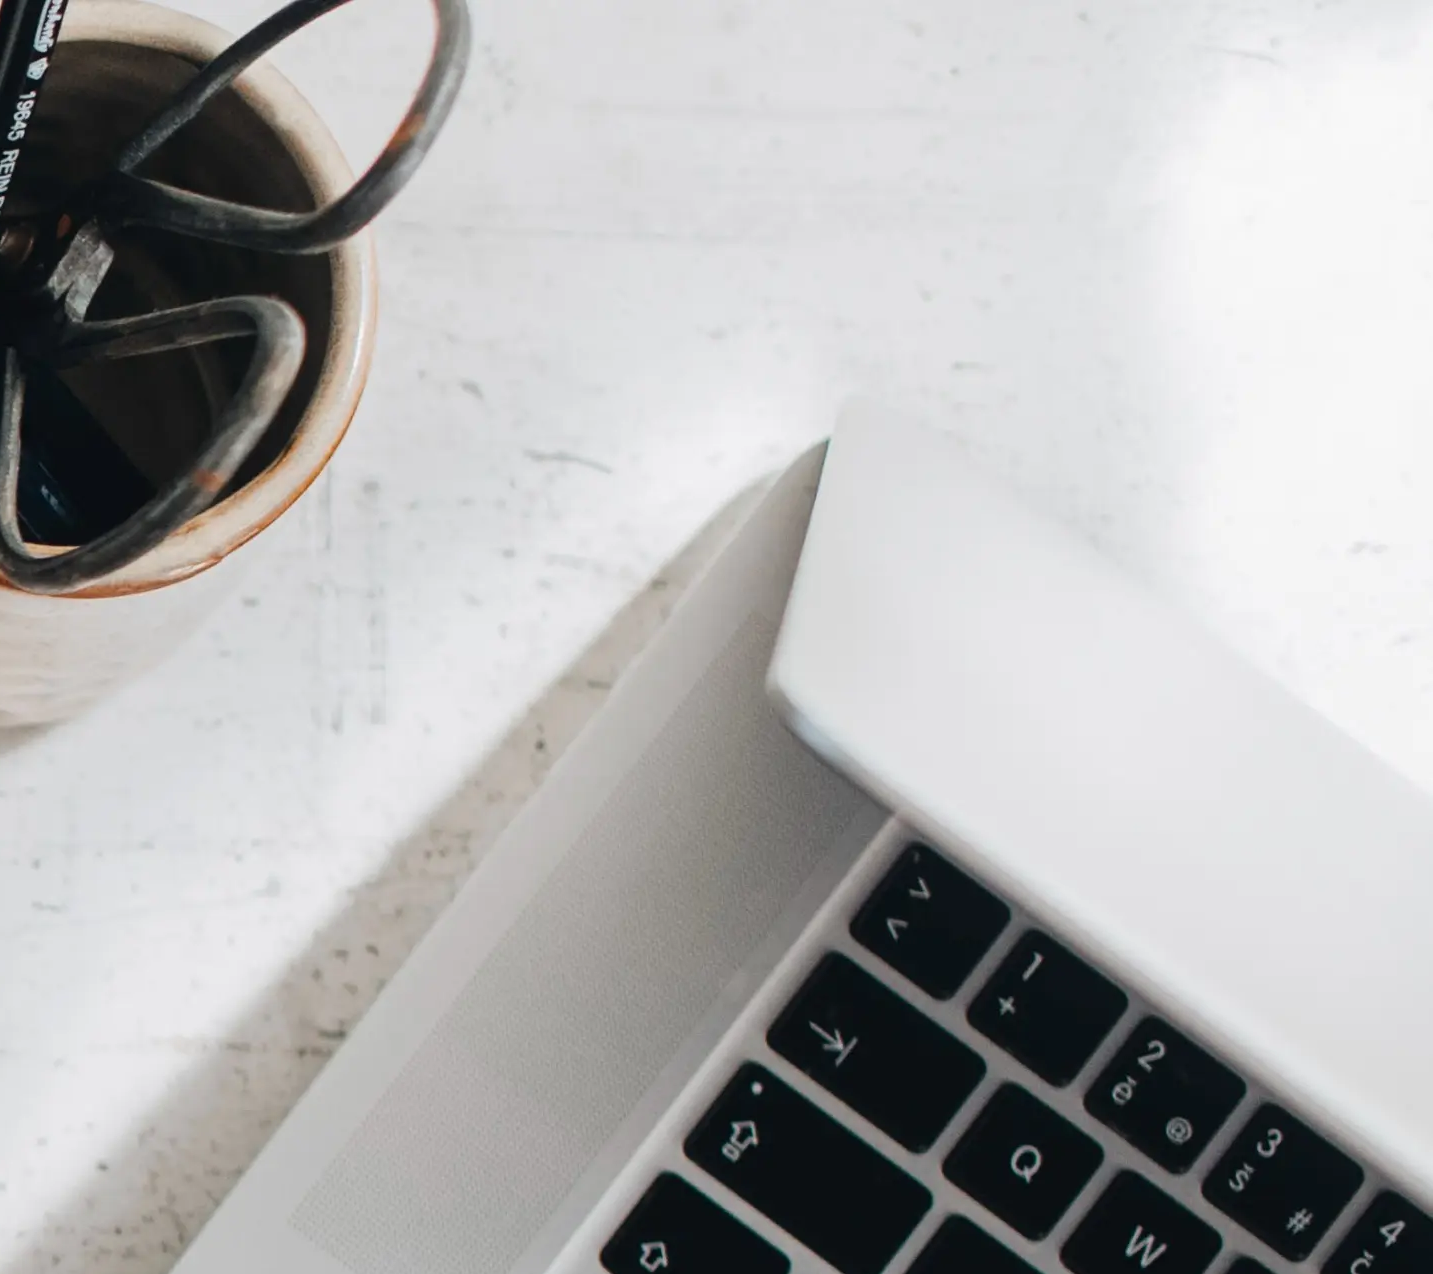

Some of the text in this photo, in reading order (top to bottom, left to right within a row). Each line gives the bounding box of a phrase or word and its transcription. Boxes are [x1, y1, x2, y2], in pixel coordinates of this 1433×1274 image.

[7, 91, 36, 141] 19645
[1022, 951, 1044, 982] 1
[1137, 1040, 1166, 1073] 2
[1165, 1116, 1193, 1145] @
[1256, 1128, 1283, 1158] 3
[1010, 1144, 1042, 1183] Q
[1125, 1225, 1167, 1268] W
[1379, 1220, 1406, 1247] 4
